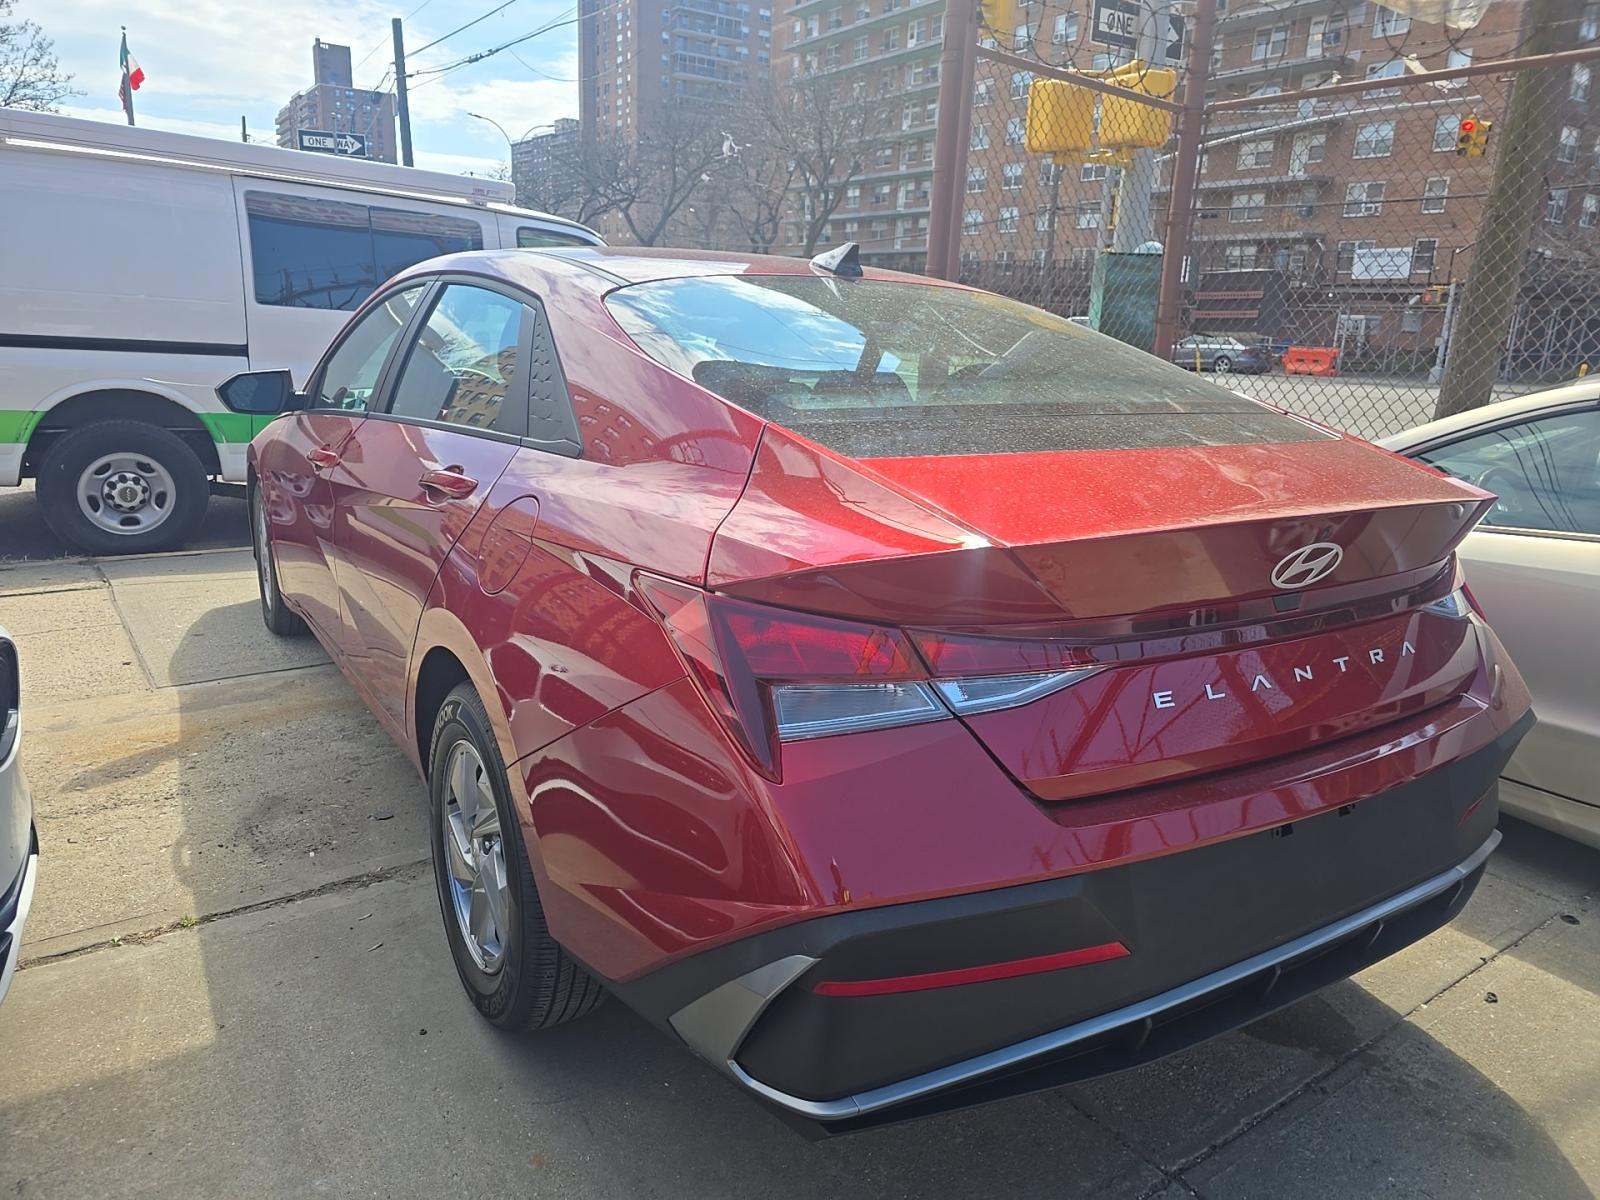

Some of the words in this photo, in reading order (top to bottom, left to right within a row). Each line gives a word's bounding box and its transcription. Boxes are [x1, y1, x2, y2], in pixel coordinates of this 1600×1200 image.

[1106, 12, 1134, 35] ONE
[308, 136, 329, 147] ONE
[335, 138, 356, 149] WAY
[1152, 641, 1416, 709] ELANTRA
